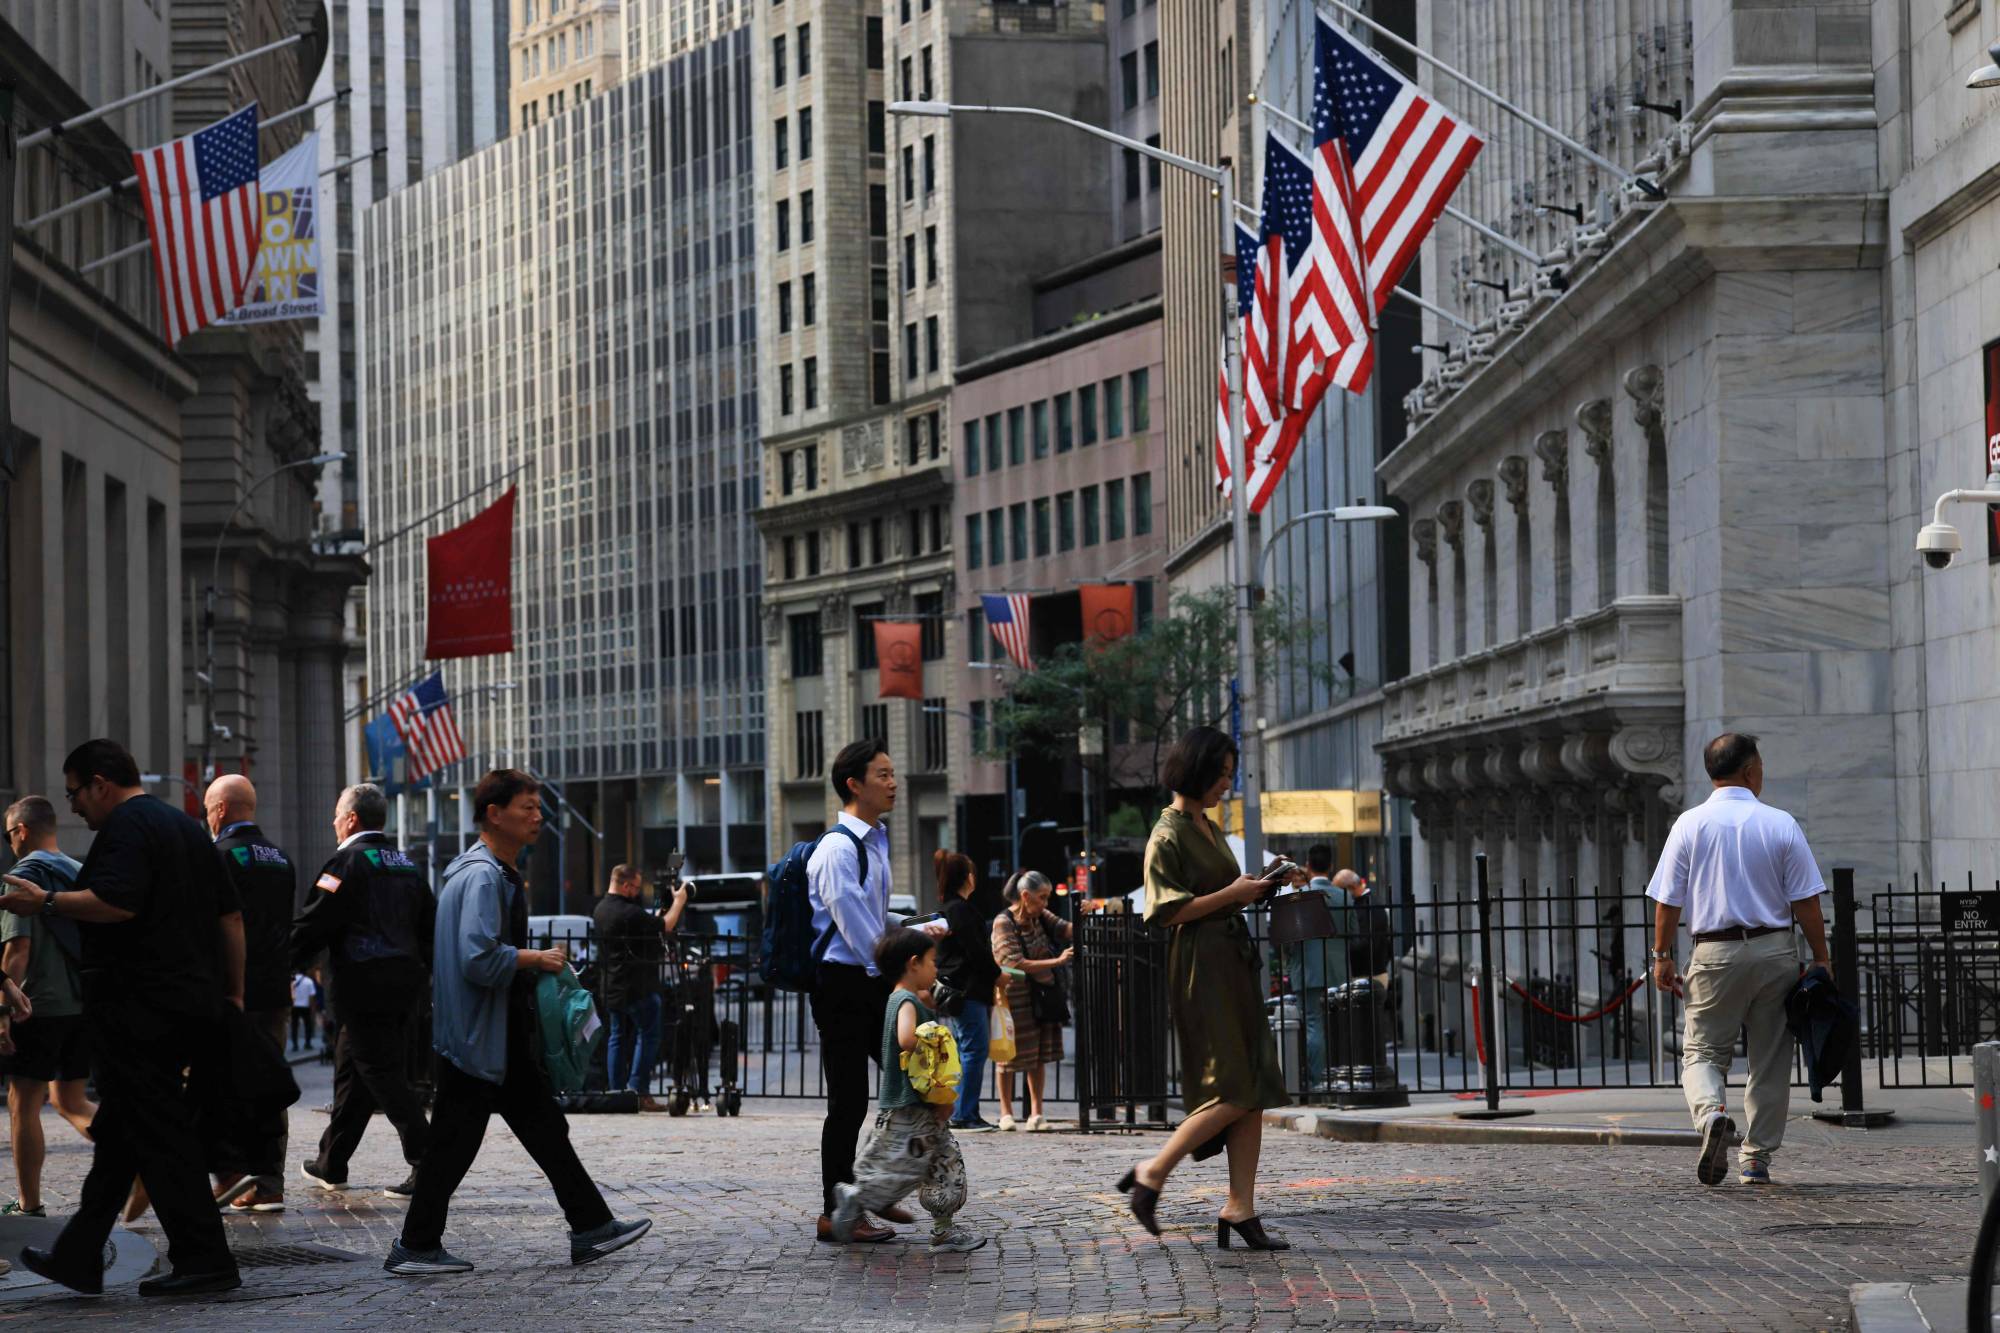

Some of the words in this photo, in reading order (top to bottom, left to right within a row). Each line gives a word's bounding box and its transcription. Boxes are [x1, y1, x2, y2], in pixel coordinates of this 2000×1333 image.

[239, 304, 277, 319] Broad
[281, 302, 318, 316] Street
[1963, 911, 1979, 919] NO
[1954, 919, 1988, 929] ENTRY
